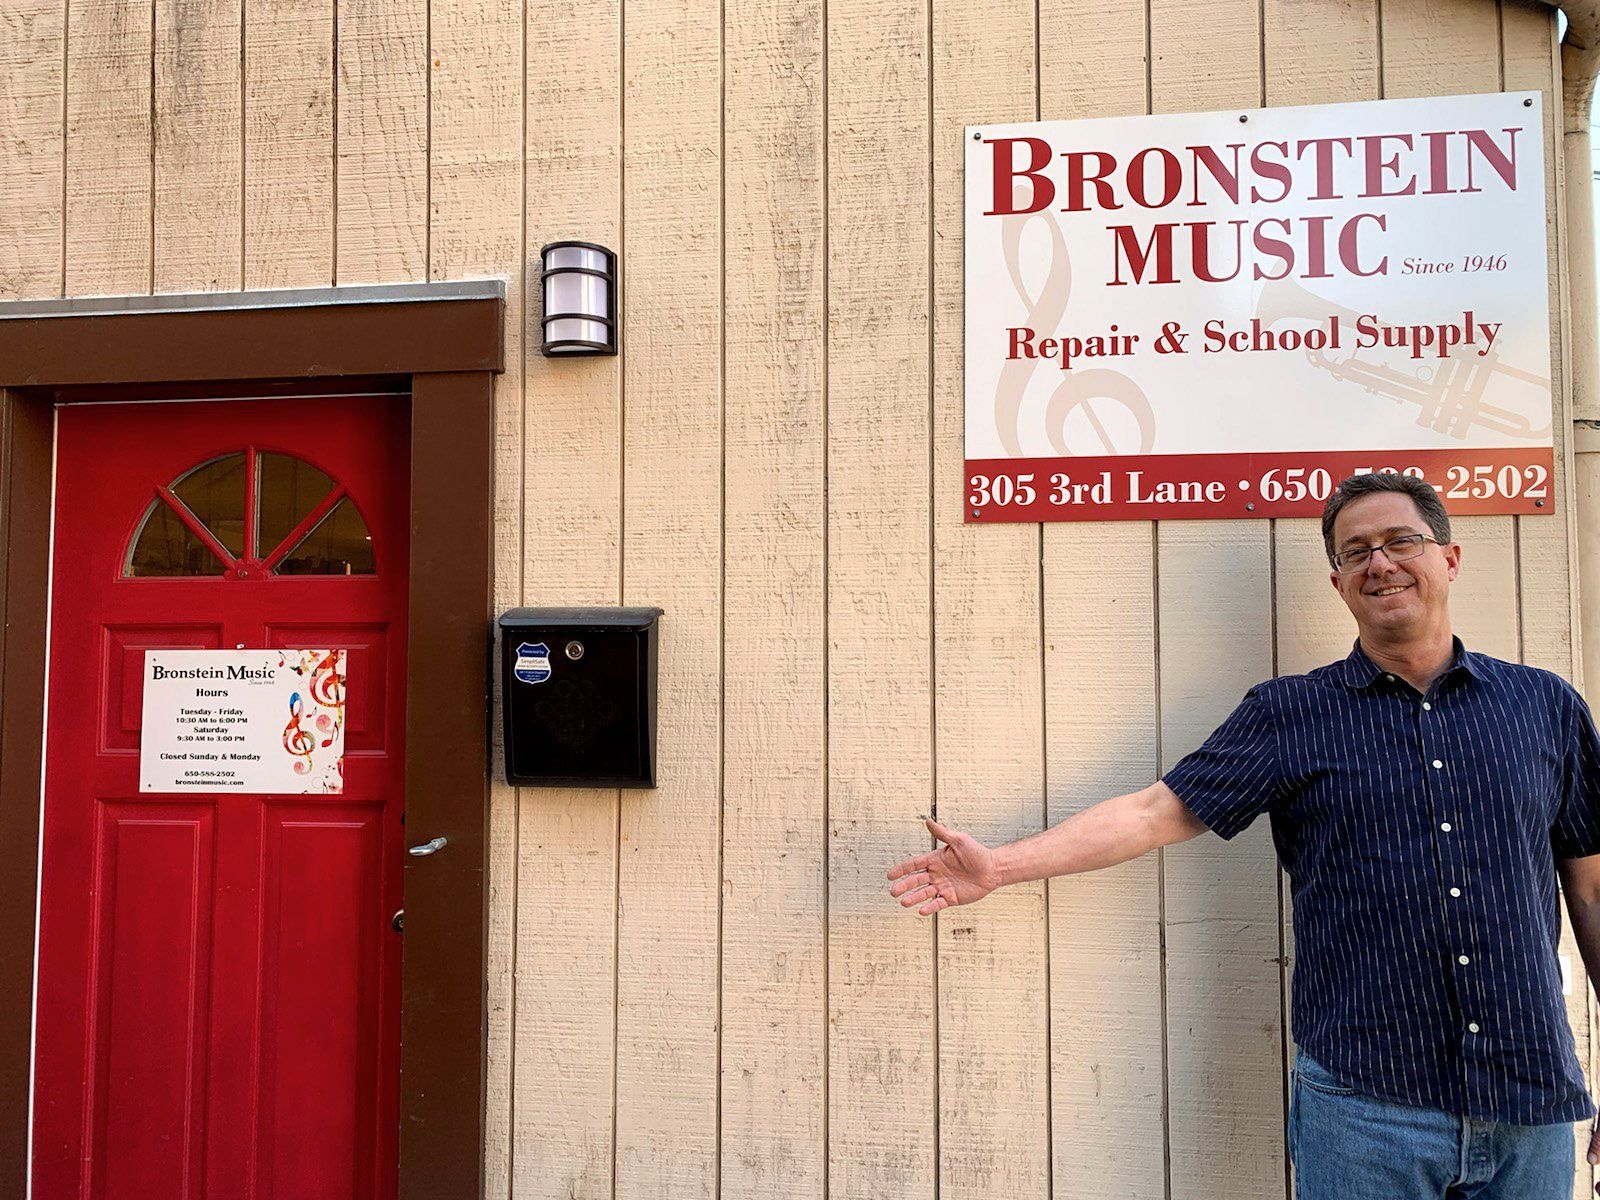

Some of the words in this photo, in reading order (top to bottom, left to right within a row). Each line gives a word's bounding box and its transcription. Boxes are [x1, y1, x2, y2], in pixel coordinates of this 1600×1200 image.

[983, 127, 1523, 216] BRONSTEIN
[1106, 213, 1389, 286] MUSIC
[1401, 258, 1454, 276] Since
[1461, 252, 1508, 273] 1946
[1005, 324, 1139, 370] Repair
[1154, 321, 1189, 354] &
[1203, 316, 1340, 353] School
[1356, 311, 1503, 358] Supply
[970, 473, 1036, 507] 305
[1049, 468, 1112, 504] 3rd
[1126, 470, 1227, 504] Lane
[152, 665, 224, 680] Bronstein
[226, 661, 275, 680] Music
[196, 688, 229, 698] Hours
[180, 708, 212, 716] Tuesday
[219, 708, 244, 716] Friday
[193, 726, 229, 734] Saturday
[160, 752, 187, 760] Closed
[189, 752, 219, 761] Sunday
[221, 752, 227, 760] &
[230, 752, 261, 761] Monday
[184, 770, 236, 778] 650-588-2502
